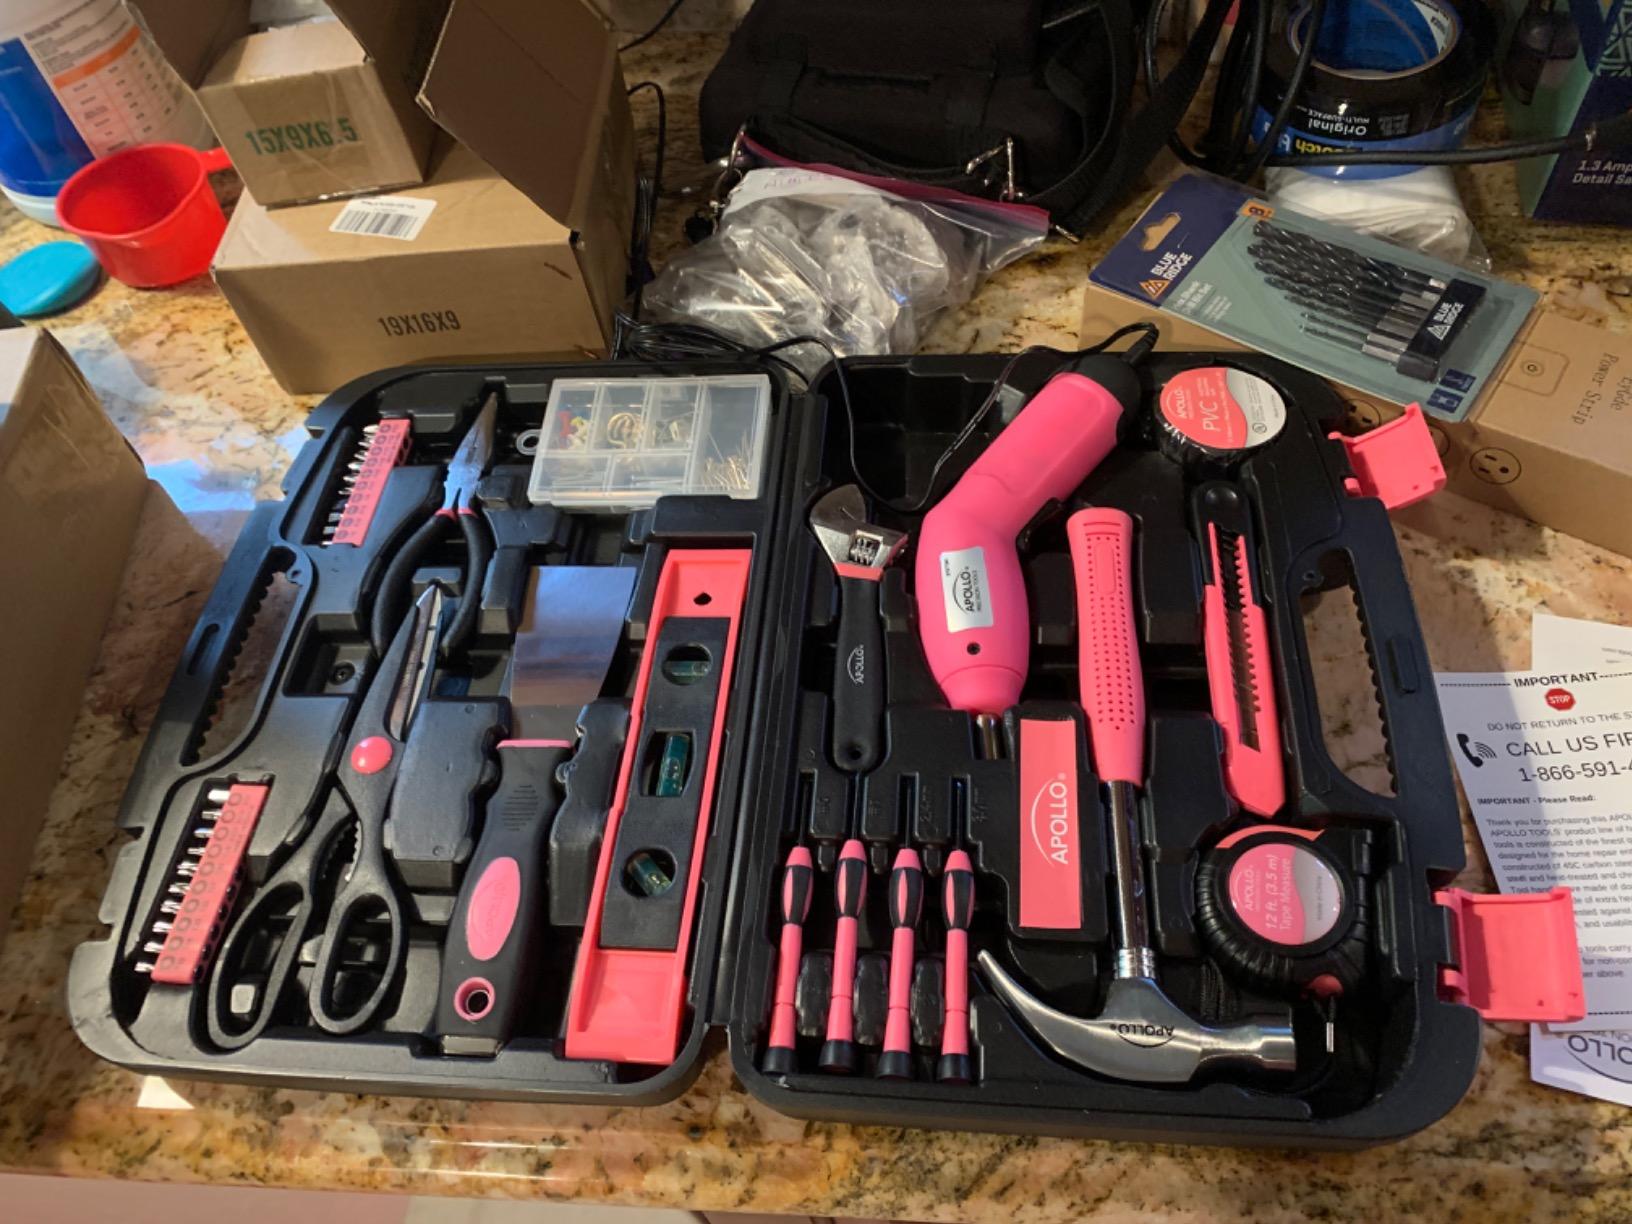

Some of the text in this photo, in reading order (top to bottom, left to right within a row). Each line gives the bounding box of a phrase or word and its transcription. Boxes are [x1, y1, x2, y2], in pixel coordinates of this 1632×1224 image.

[245, 118, 358, 155] 15X9X6.5
[1308, 117, 1367, 136] Original
[1578, 160, 1601, 171] 1.3
[1572, 173, 1614, 185] Detail
[1150, 252, 1178, 276] BLUE
[1163, 252, 1193, 281] RIDGE
[1433, 302, 1452, 321] BLUE
[1443, 302, 1464, 325] RIDGE
[378, 309, 461, 337] 19X16X9
[1571, 352, 1619, 425] Power Strip
[1174, 387, 1187, 419] APOLLO
[1200, 400, 1220, 432] PVC
[961, 571, 974, 612] APOLLO
[855, 647, 864, 684] APOLLO
[1514, 672, 1598, 687] IMPORTANT
[1548, 695, 1571, 704] STOP
[1487, 723, 1503, 731] DO
[1506, 721, 1528, 730] NOT
[1530, 718, 1577, 729] RETURN
[1580, 715, 1595, 724] TO
[1598, 713, 1622, 722] THE
[1506, 740, 1562, 757] CALL
[1566, 736, 1598, 752] US
[1477, 797, 1530, 805] IMPORTANT
[1538, 796, 1567, 804] Please
[1050, 781, 1068, 865] APOLLO
[1486, 818, 1511, 826] Thank
[1514, 819, 1529, 827] you
[1530, 817, 1541, 825] for
[1491, 829, 1526, 837] APOLLO
[1493, 840, 1515, 848] tools
[1497, 851, 1536, 861] designed
[1502, 862, 1551, 870] constructed
[1244, 868, 1255, 911] APOLLO
[1265, 872, 1279, 896] (3.5
[1280, 858, 1293, 930] Tape Measure
[1265, 914, 1278, 929] 12
[1118, 1023, 1175, 1037] APOLLO
